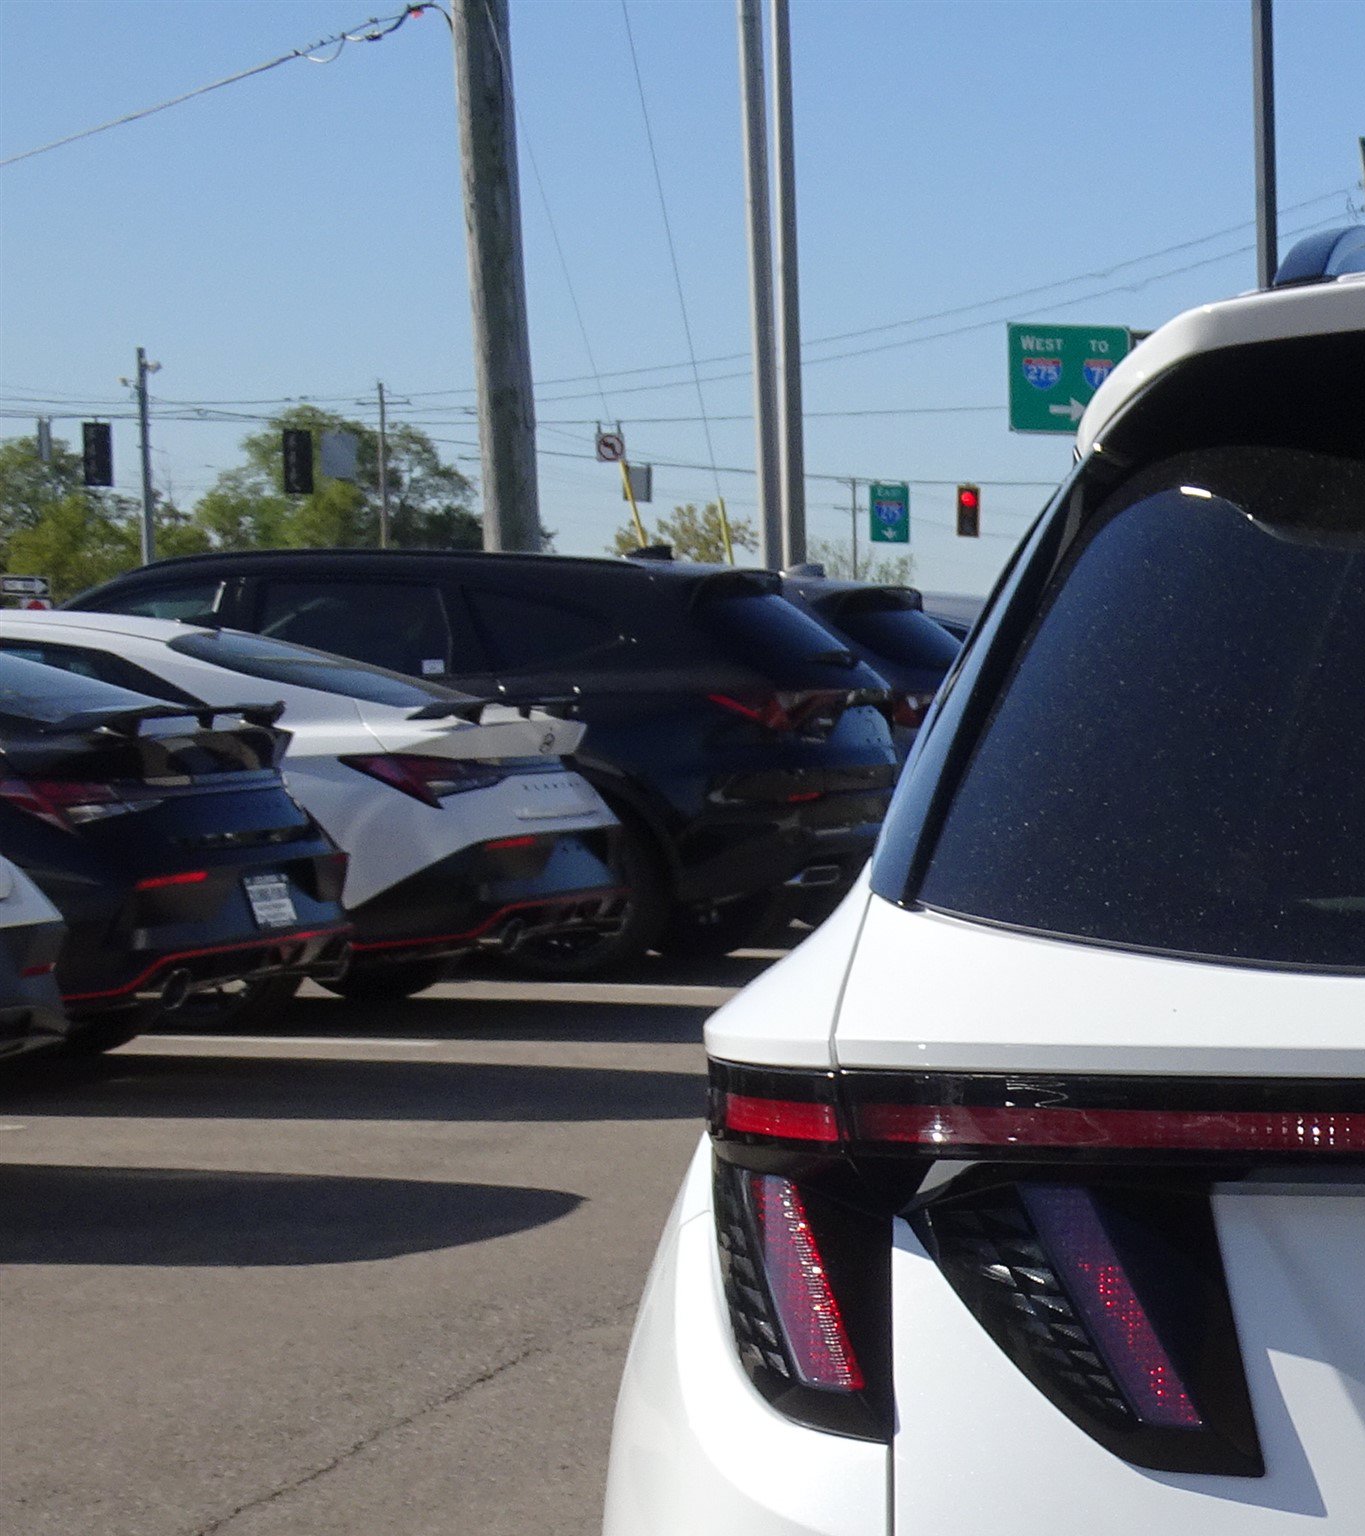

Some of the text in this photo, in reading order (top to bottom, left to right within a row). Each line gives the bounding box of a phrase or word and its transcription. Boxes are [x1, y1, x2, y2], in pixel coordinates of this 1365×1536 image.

[1019, 335, 1109, 353] WEST TO
[1027, 365, 1058, 381] 275
